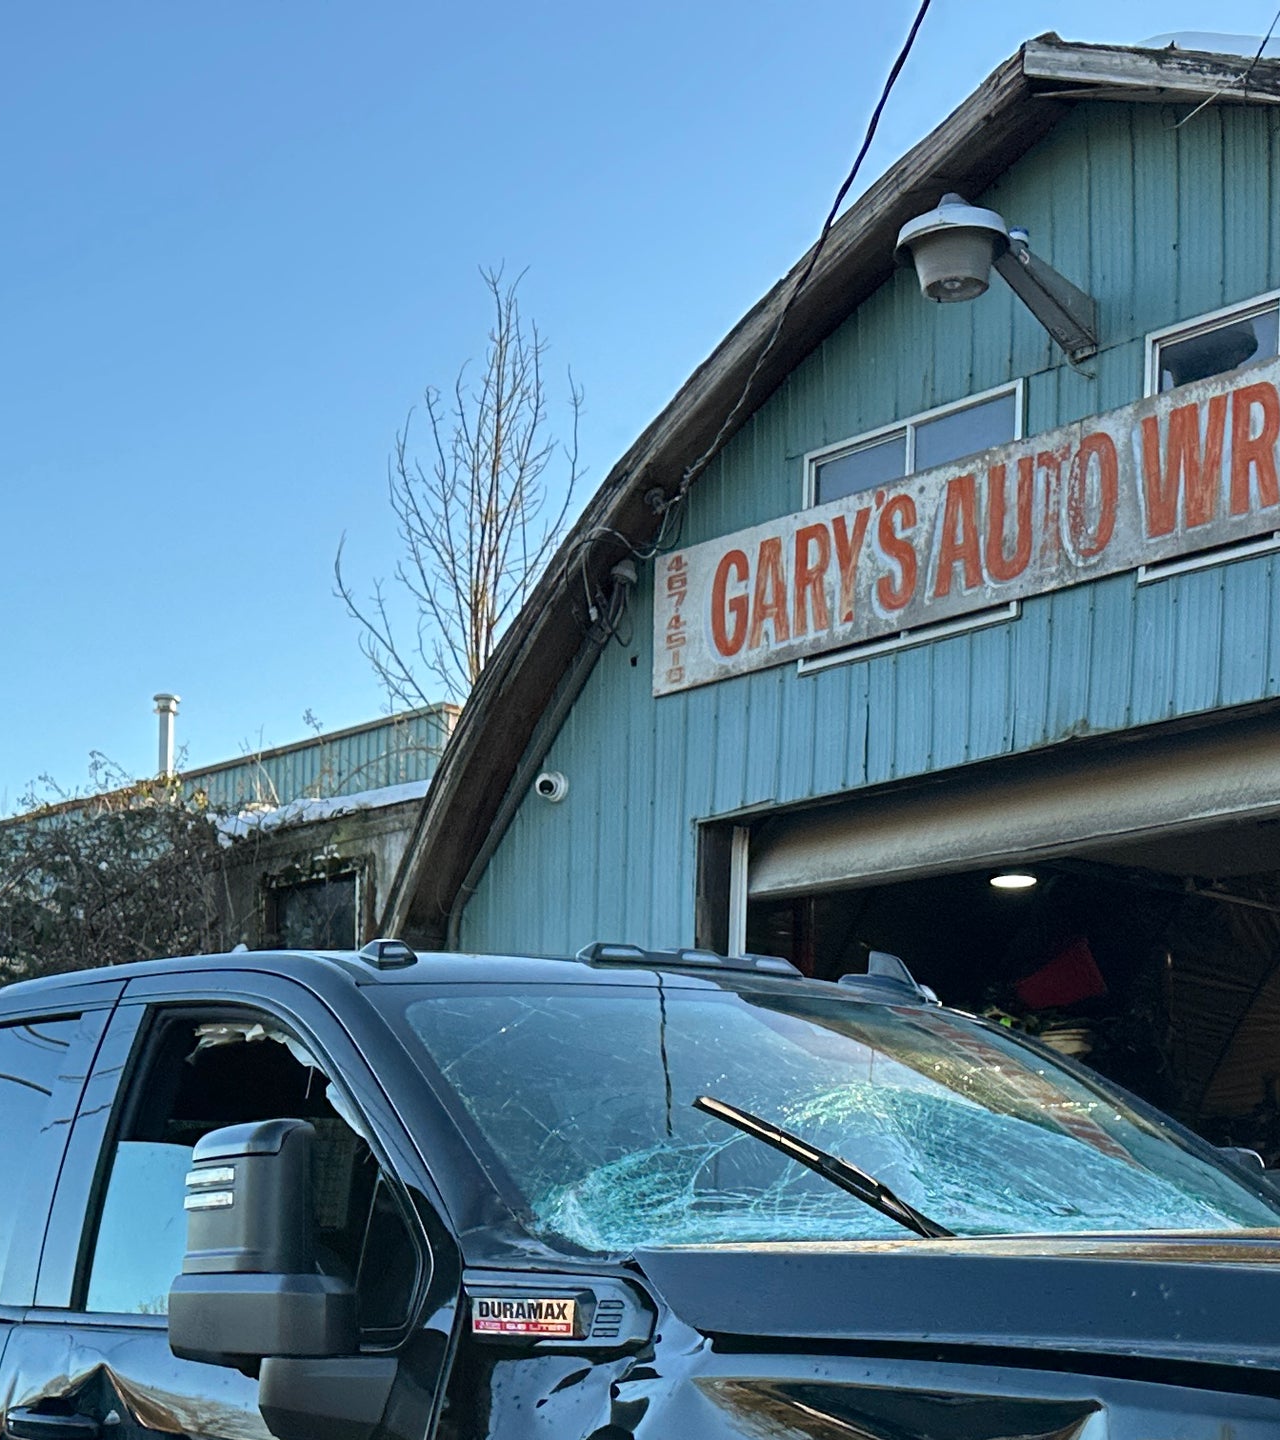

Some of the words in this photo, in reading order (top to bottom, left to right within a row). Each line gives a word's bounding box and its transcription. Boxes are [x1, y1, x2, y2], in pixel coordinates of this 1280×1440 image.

[711, 493, 918, 657] GARY'S
[934, 431, 1118, 598] AUTO
[478, 1301, 568, 1321] DURAMAX
